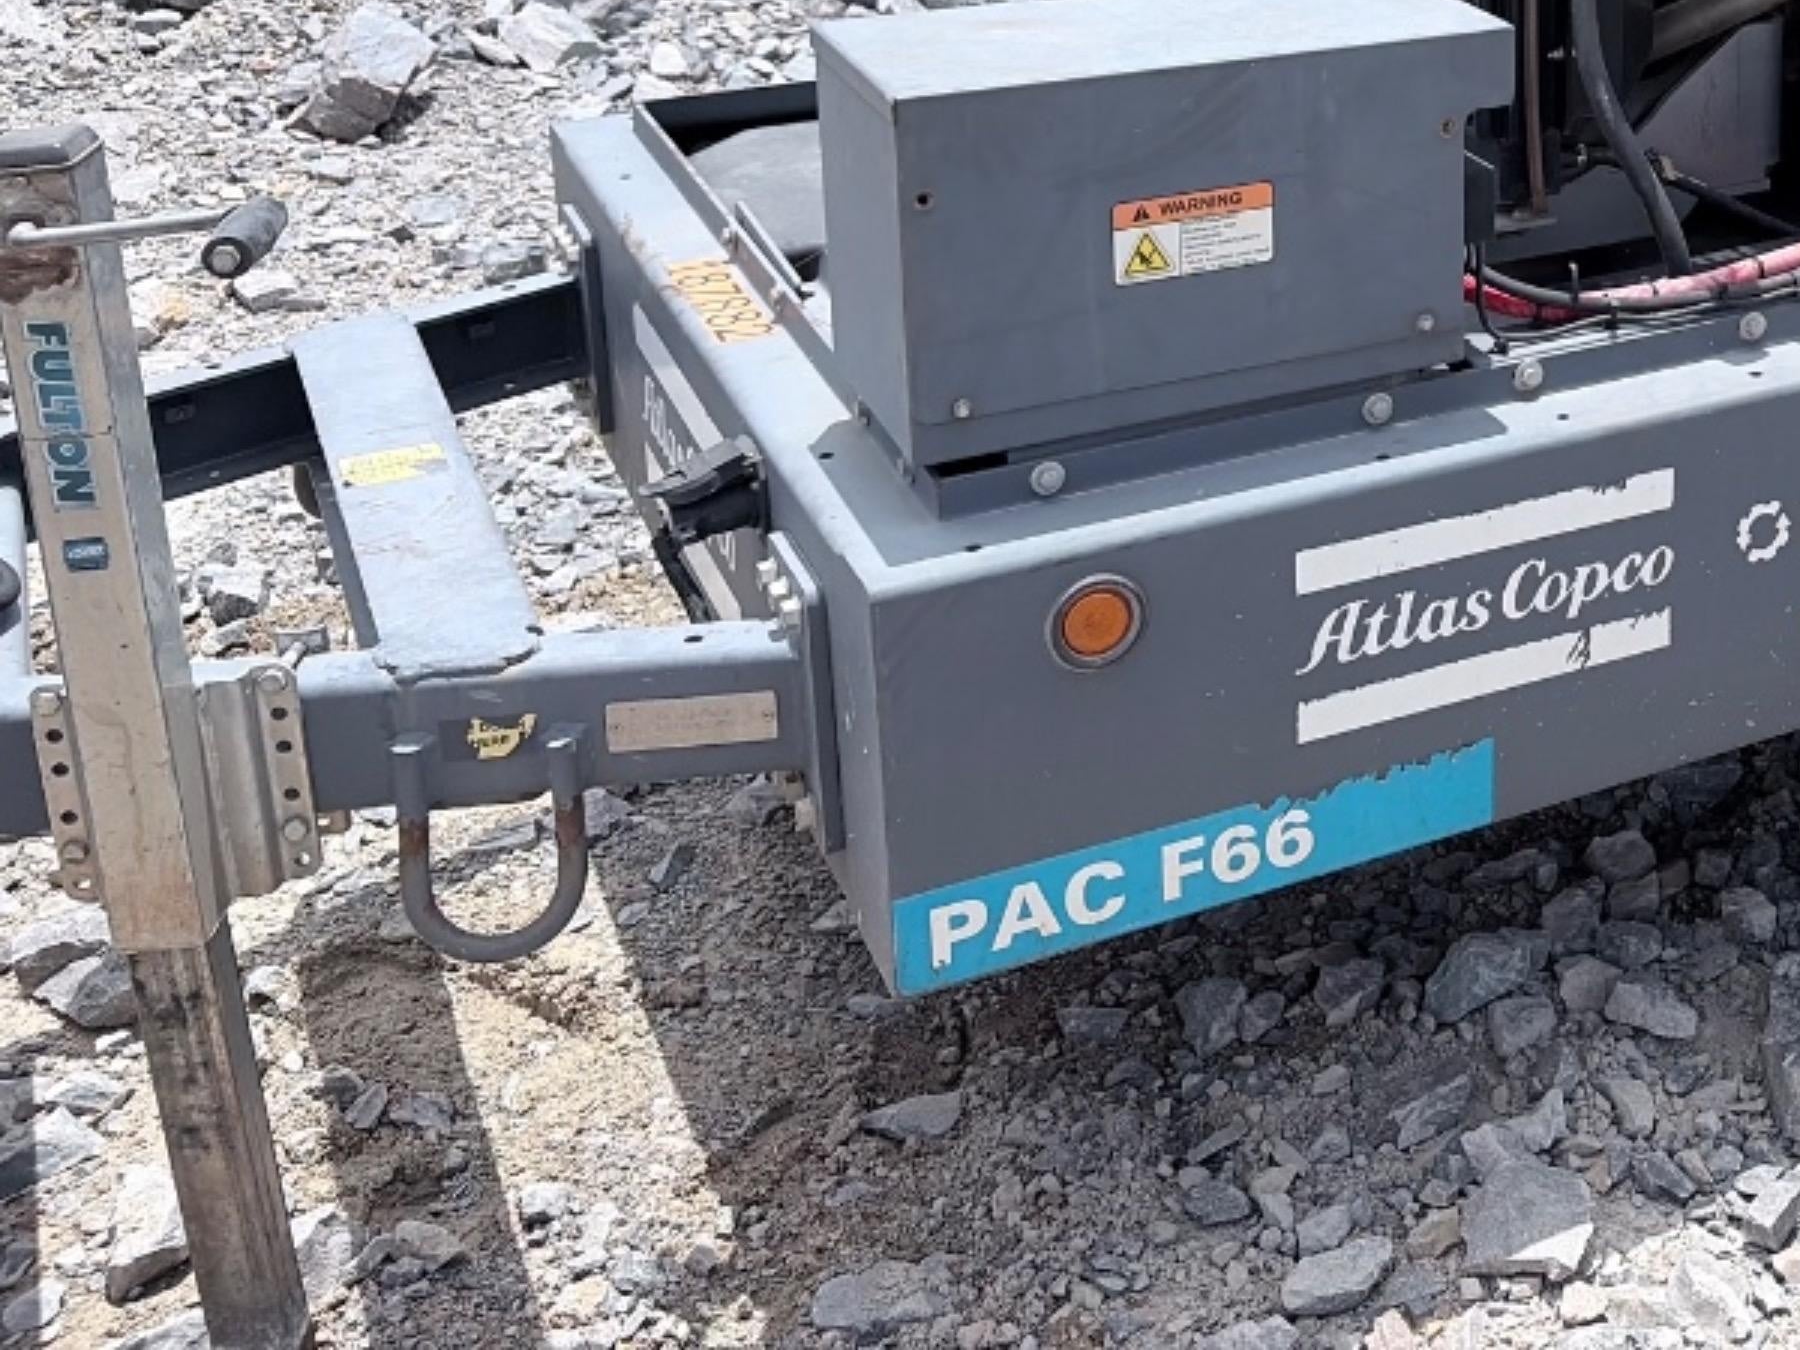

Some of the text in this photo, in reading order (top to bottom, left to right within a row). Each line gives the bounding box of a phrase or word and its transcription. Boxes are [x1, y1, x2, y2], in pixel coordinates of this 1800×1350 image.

[1158, 191, 1243, 216] WARNING
[23, 319, 98, 506] FULTON
[1296, 544, 1675, 676] Atlas Copco
[928, 809, 1316, 971] PAC F66
